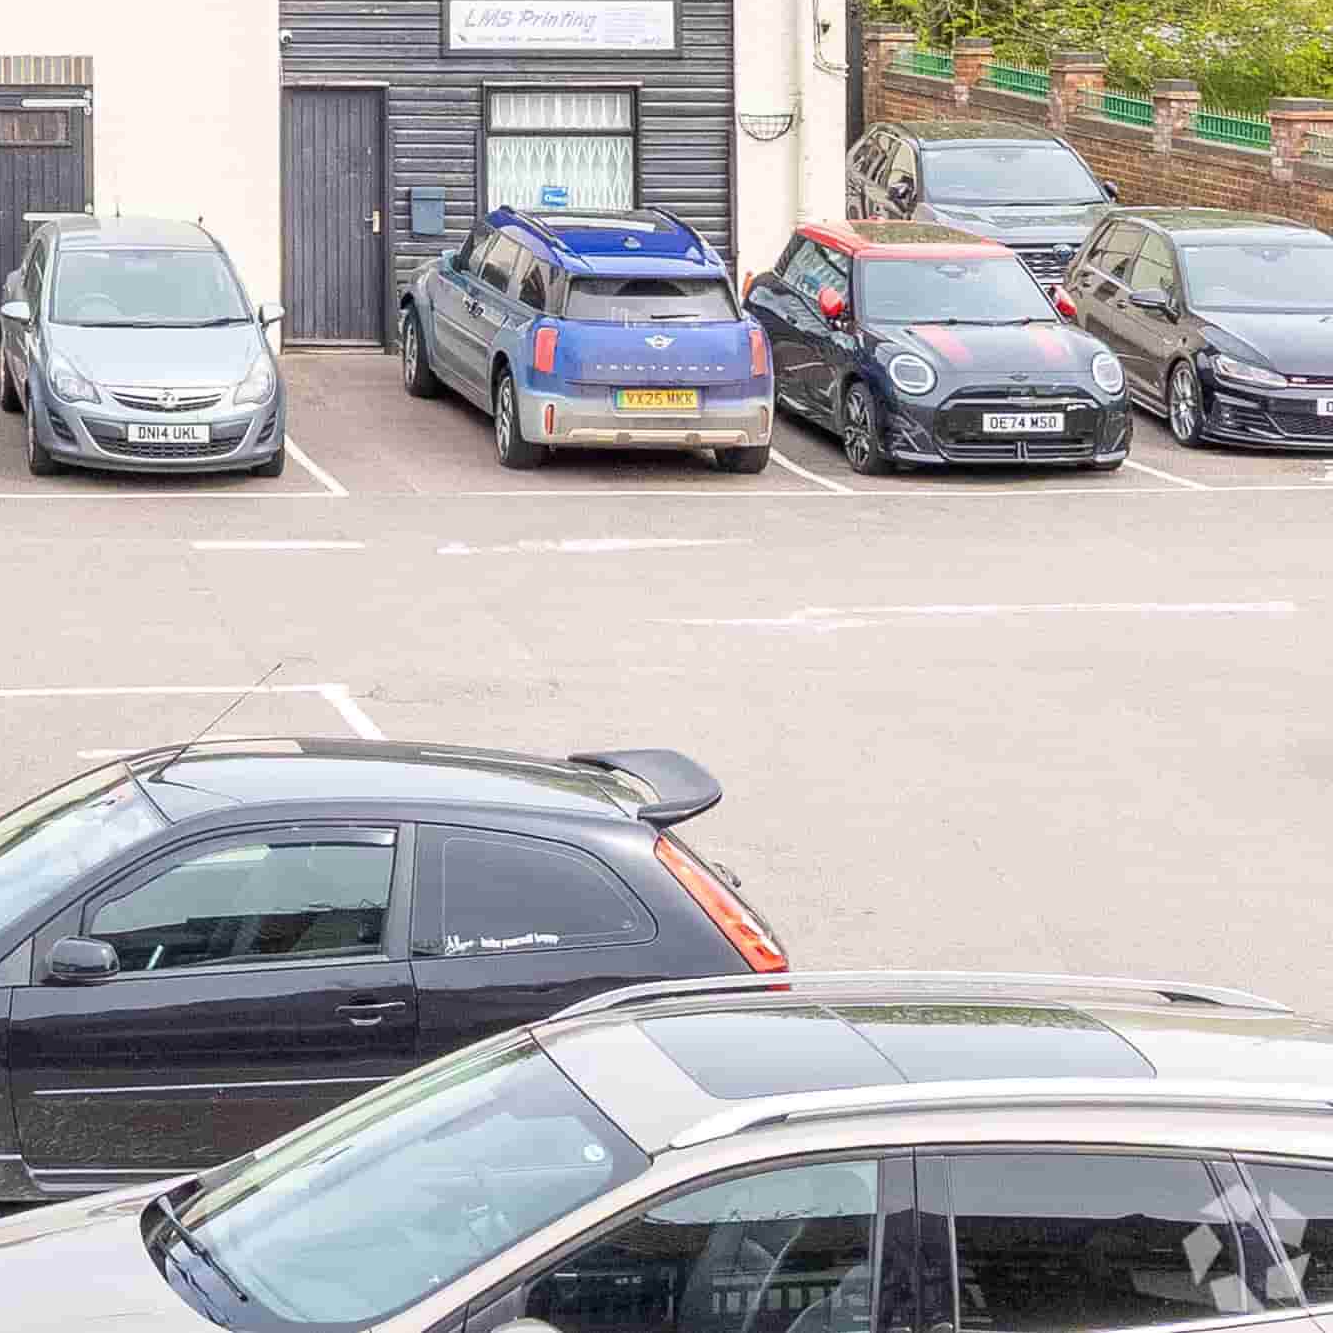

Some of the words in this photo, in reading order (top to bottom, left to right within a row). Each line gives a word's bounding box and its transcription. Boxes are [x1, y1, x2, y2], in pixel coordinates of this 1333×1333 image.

[464, 8, 513, 28] LMS
[517, 8, 597, 33] Printing
[989, 416, 1025, 429] OE74
[139, 427, 167, 439] DN14
[173, 427, 200, 439] UKL
